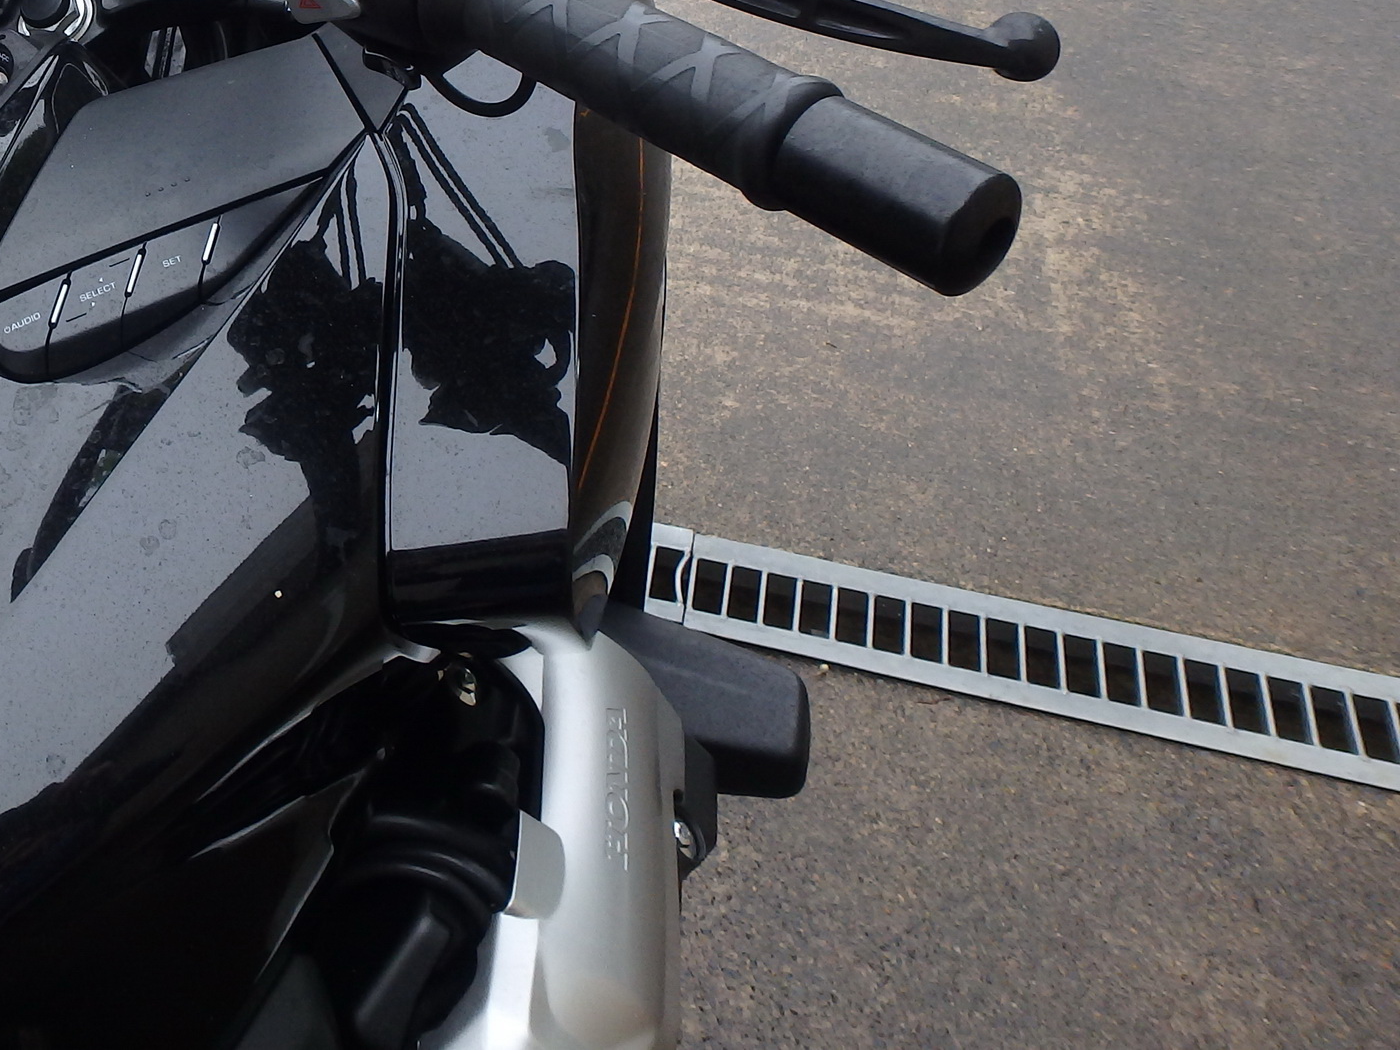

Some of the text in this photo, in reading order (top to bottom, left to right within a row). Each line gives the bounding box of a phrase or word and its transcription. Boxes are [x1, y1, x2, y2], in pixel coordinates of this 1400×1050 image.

[162, 255, 183, 268] SET
[79, 282, 117, 302] SELECT
[10, 312, 42, 332] AUDIO
